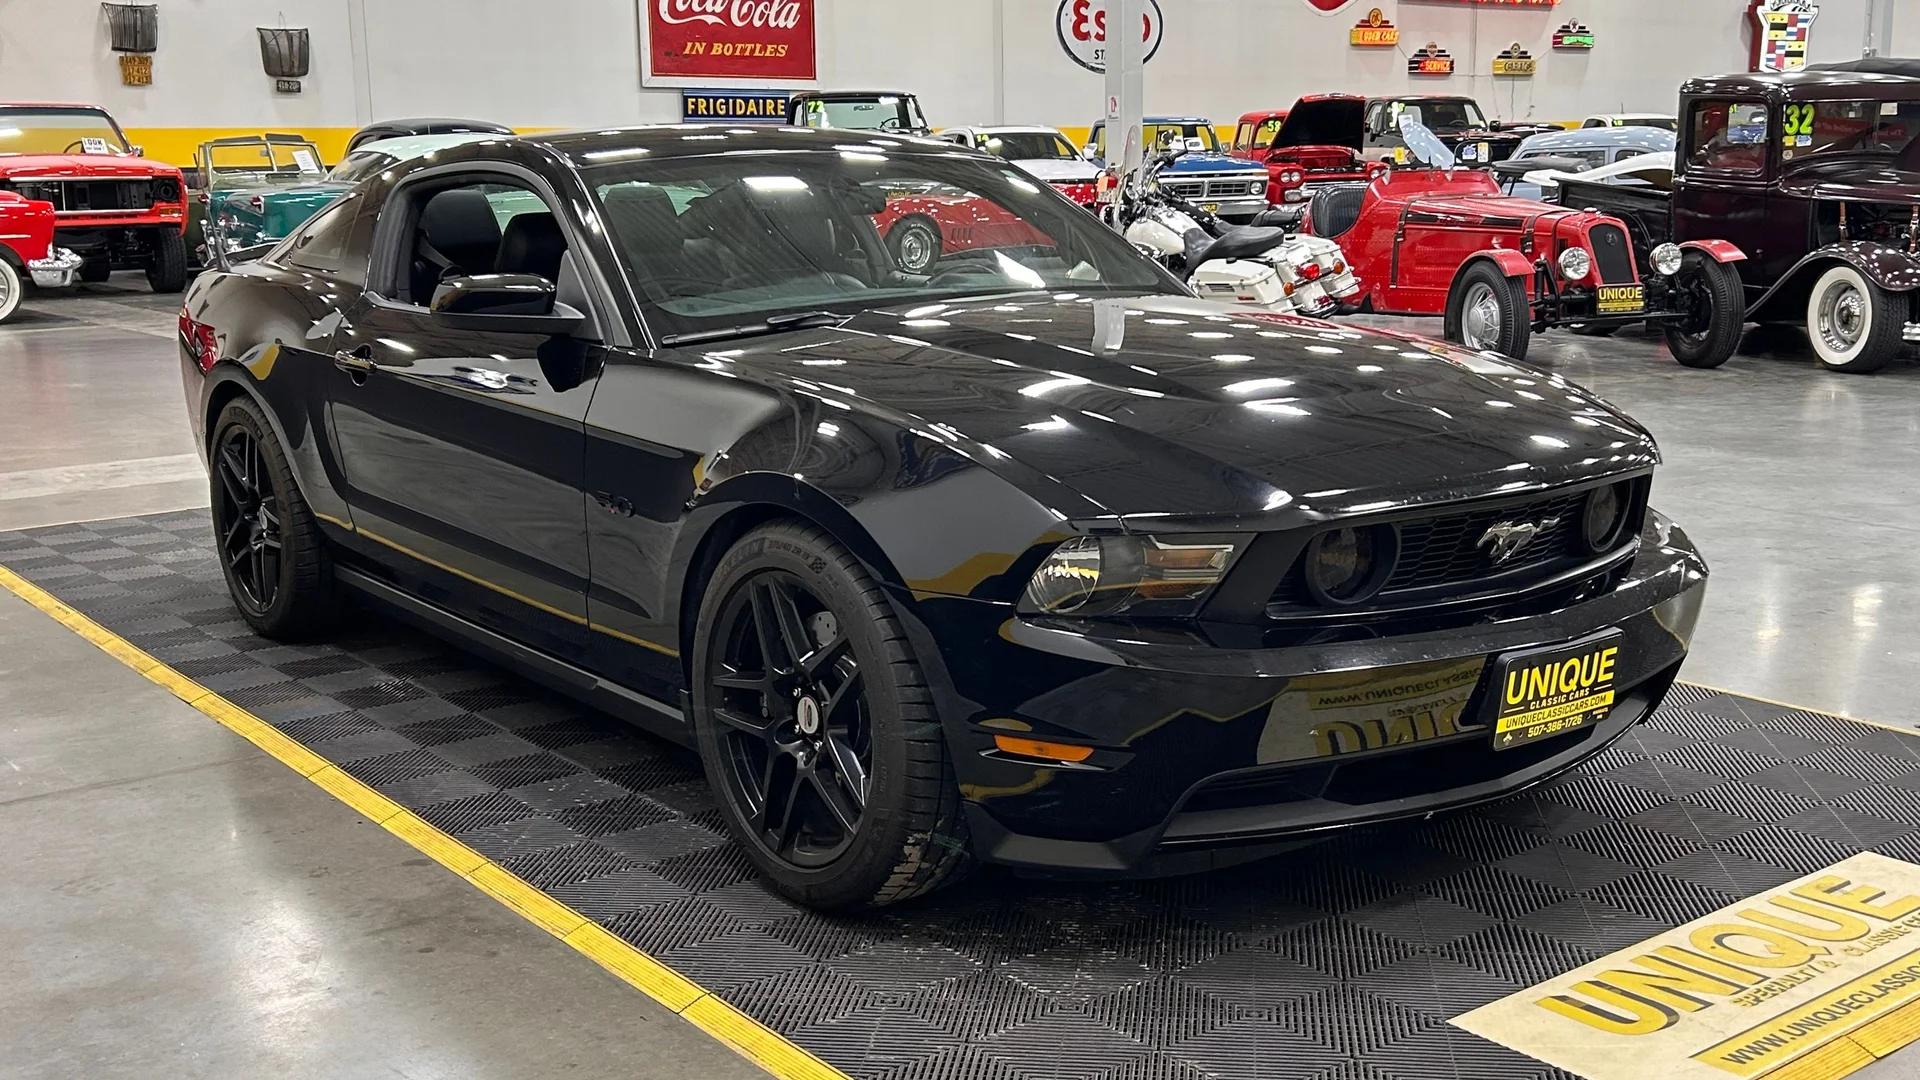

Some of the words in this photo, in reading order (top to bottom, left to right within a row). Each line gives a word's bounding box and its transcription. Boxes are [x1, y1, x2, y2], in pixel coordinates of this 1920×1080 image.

[683, 42, 707, 55] IN
[710, 43, 788, 57] BOTTLES
[687, 98, 786, 116] FRIGIDAIRE
[1268, 120, 1281, 132] 58
[1785, 104, 1815, 135] 32
[1598, 287, 1643, 300] UNIQUE
[1506, 646, 1618, 705] UNIQUE
[1529, 695, 1567, 710] CLASSIC
[1569, 688, 1590, 701] CARS
[1505, 694, 1607, 729] UNIQUECLASSICCARS.COM
[1527, 714, 1583, 738] 507-386-1726
[1534, 875, 1920, 1036] UNIQUE
